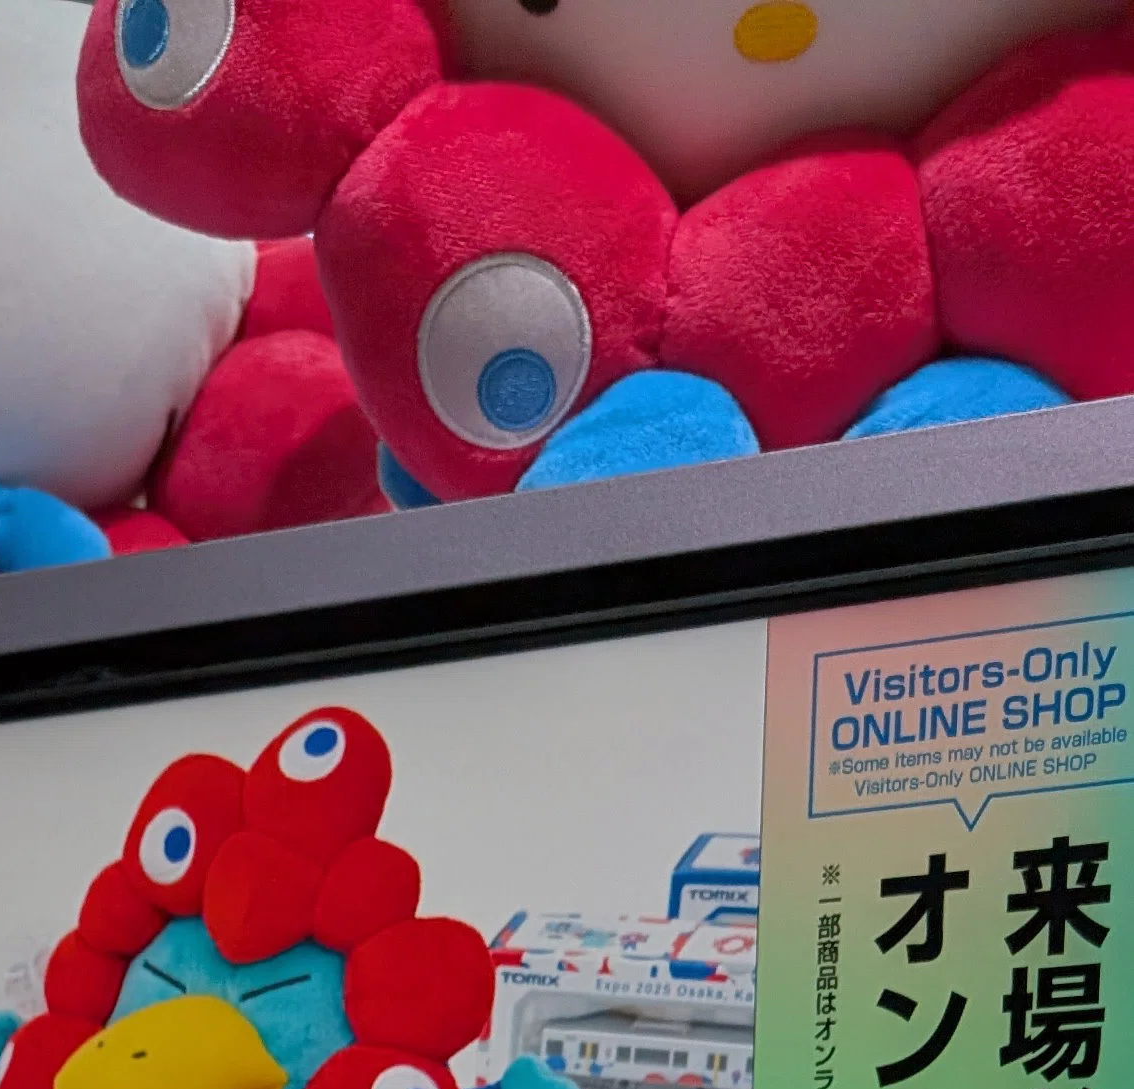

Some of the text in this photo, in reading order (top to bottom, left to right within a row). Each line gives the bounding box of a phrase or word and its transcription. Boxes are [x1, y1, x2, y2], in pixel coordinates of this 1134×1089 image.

[843, 641, 1118, 706] Visitors-Only
[830, 683, 1126, 751] ONLINE SHOP
[947, 746, 983, 764] may
[989, 739, 1018, 757] not
[1024, 735, 1046, 753] be
[1050, 726, 1127, 749] available
[854, 752, 1097, 797] Visitors-Only ONLINE SHOP
[688, 889, 749, 903] TOMIX
[501, 970, 561, 988] TOMIX
[636, 981, 671, 996] 2025
